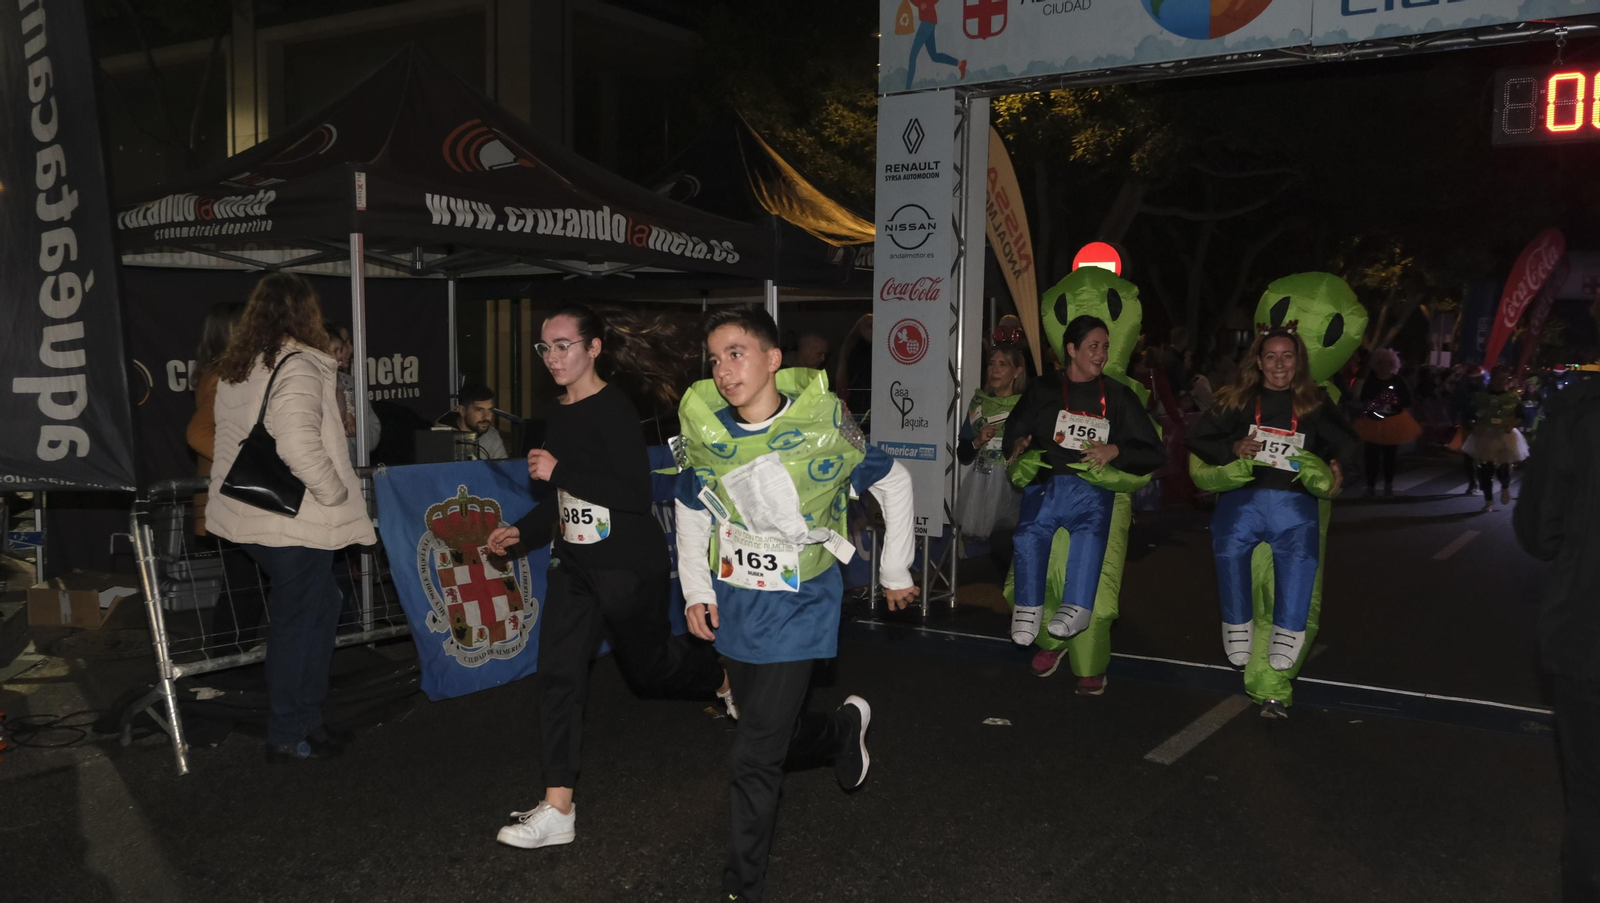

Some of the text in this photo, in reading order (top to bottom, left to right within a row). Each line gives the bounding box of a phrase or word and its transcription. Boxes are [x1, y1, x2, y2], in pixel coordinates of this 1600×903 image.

[1042, 0, 1092, 16] CIUDAD
[1545, 72, 1600, 132] 0
[885, 161, 941, 173] RENAULT
[884, 172, 940, 182] SYRSA AUTOMOCION
[154, 218, 273, 241] cronometraje deportivo
[425, 192, 741, 264] www.cruzandolameta.es
[885, 222, 937, 232] NISSAN
[889, 252, 935, 260] andalmotor.es
[880, 276, 945, 302] Coca-Cola
[901, 397, 929, 432] Paquita
[1068, 424, 1097, 439] 156
[880, 443, 919, 458] Almericar
[1260, 439, 1291, 455] 157
[563, 507, 593, 525] 985
[734, 548, 778, 571] 163
[463, 652, 487, 664] CIUDAD
[495, 643, 522, 656] ALMERIA
